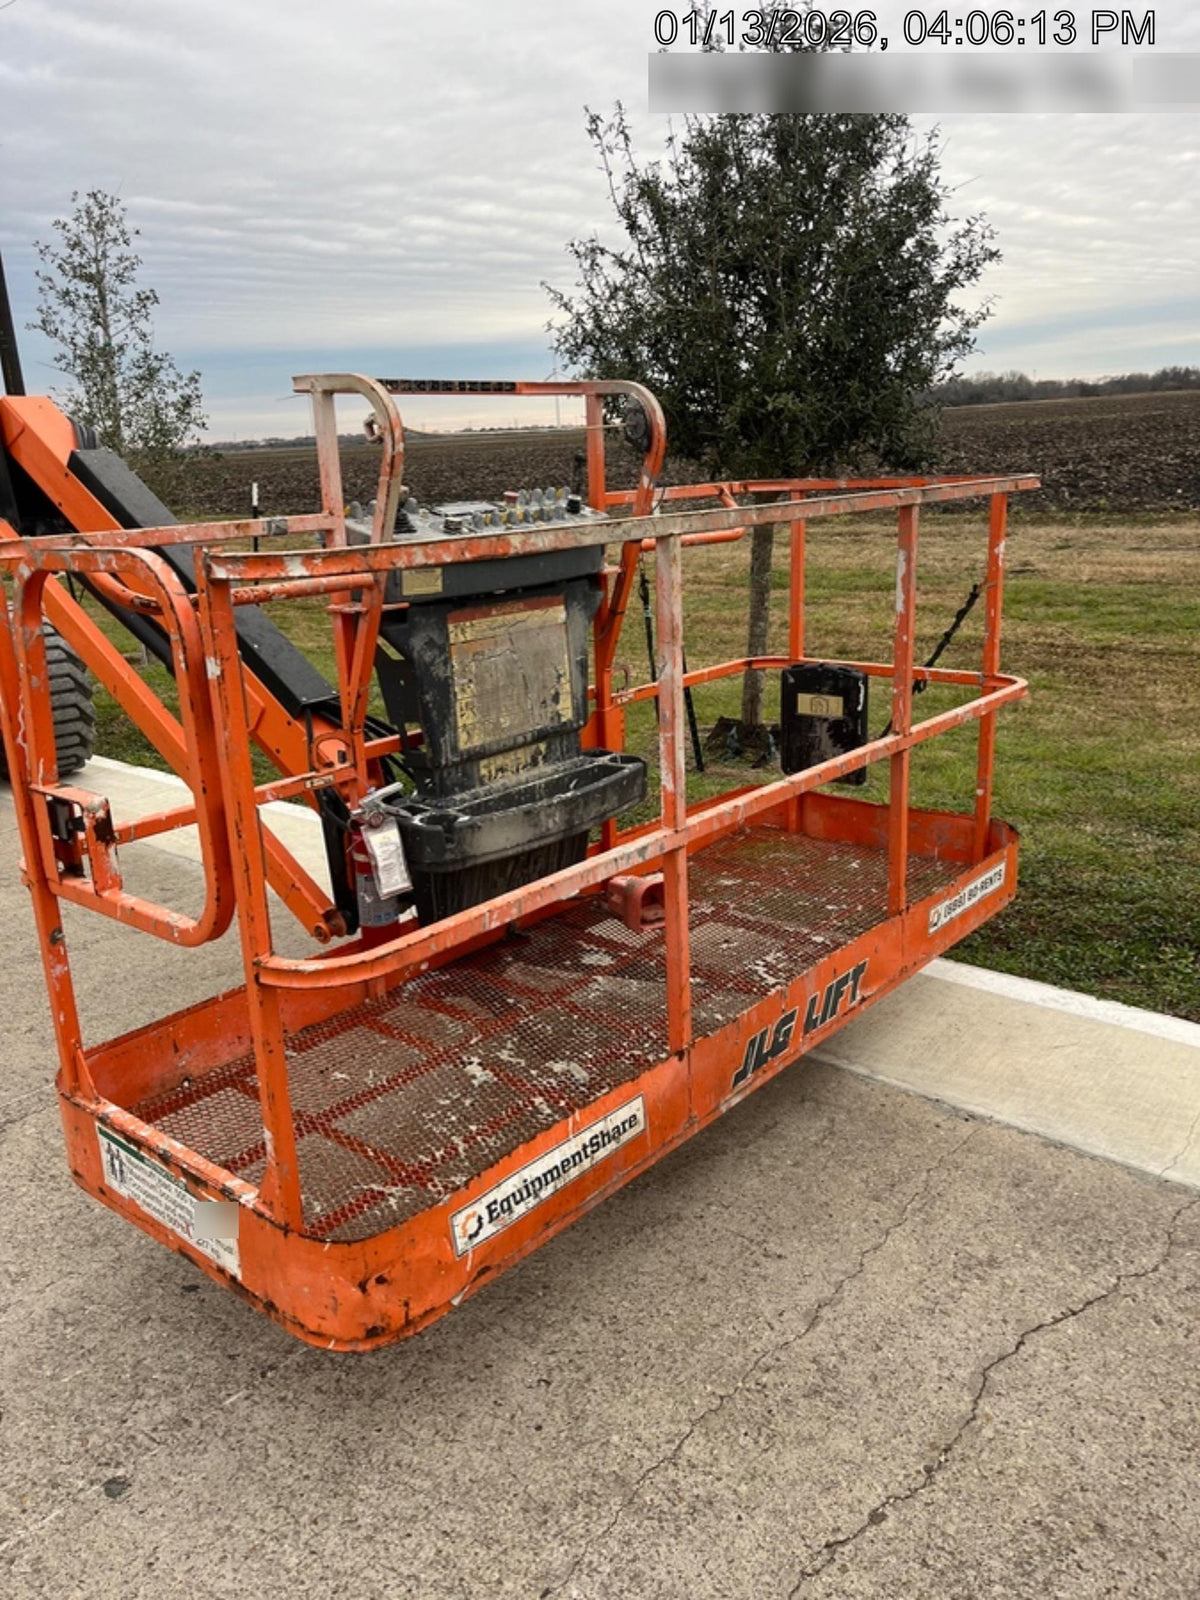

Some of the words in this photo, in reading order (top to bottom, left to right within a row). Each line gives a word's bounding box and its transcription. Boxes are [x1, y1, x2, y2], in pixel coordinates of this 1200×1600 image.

[732, 1006, 798, 1089] JLG
[802, 958, 869, 1036] LIFT
[485, 1113, 638, 1225] EquipmentShare
